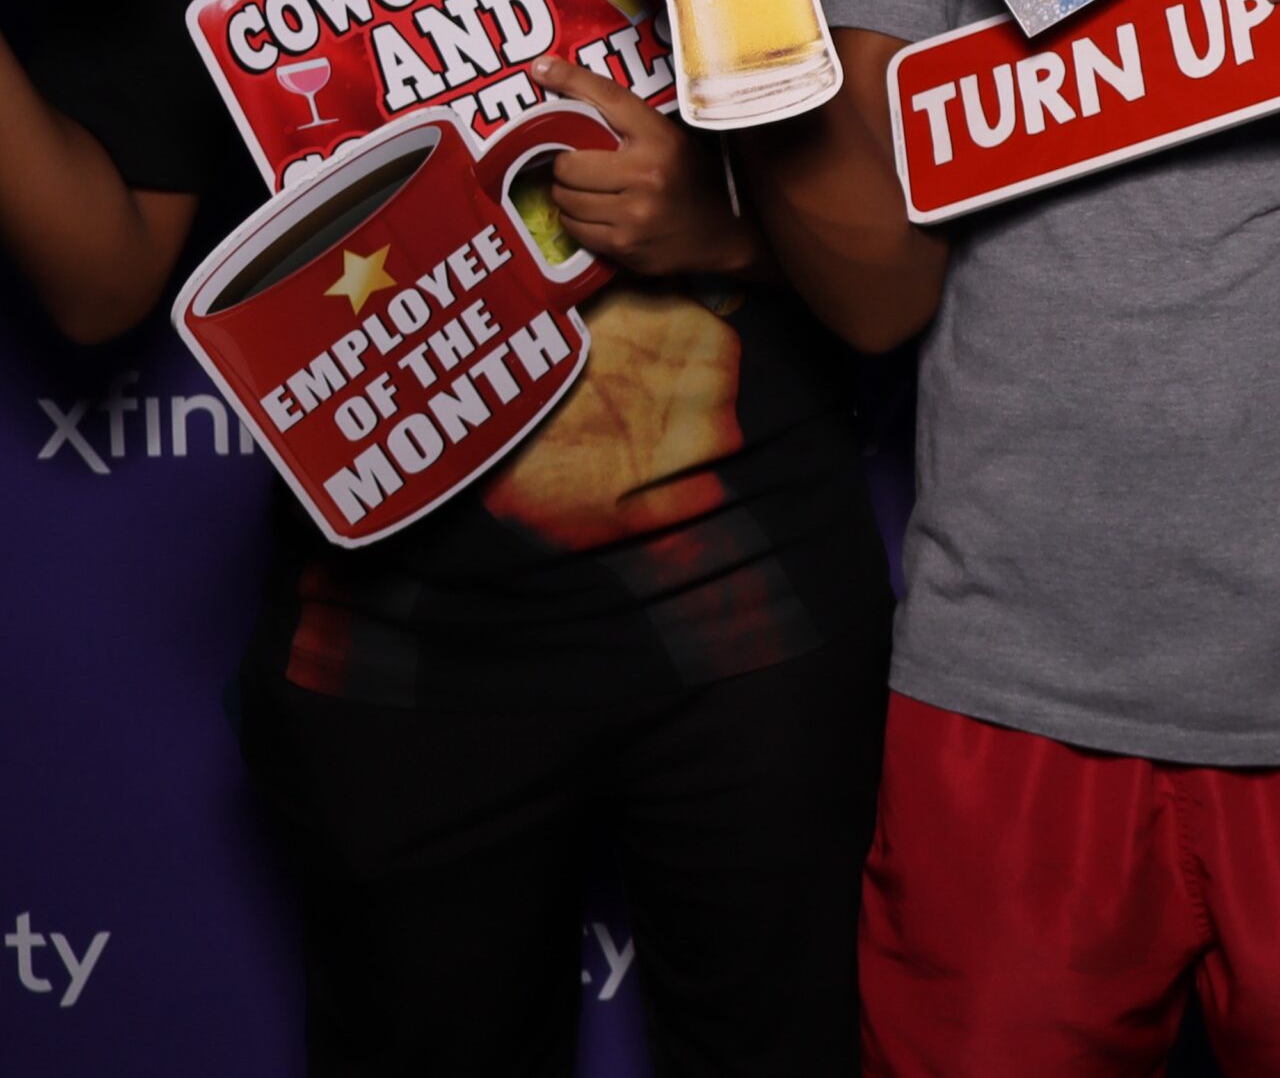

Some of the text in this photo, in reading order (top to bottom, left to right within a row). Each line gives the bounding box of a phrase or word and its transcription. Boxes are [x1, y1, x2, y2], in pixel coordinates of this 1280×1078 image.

[911, 22, 1146, 166] TURN
[260, 224, 513, 432] EMPLOYEE
[333, 299, 501, 441] OF THE
[323, 310, 572, 525] MONTH
